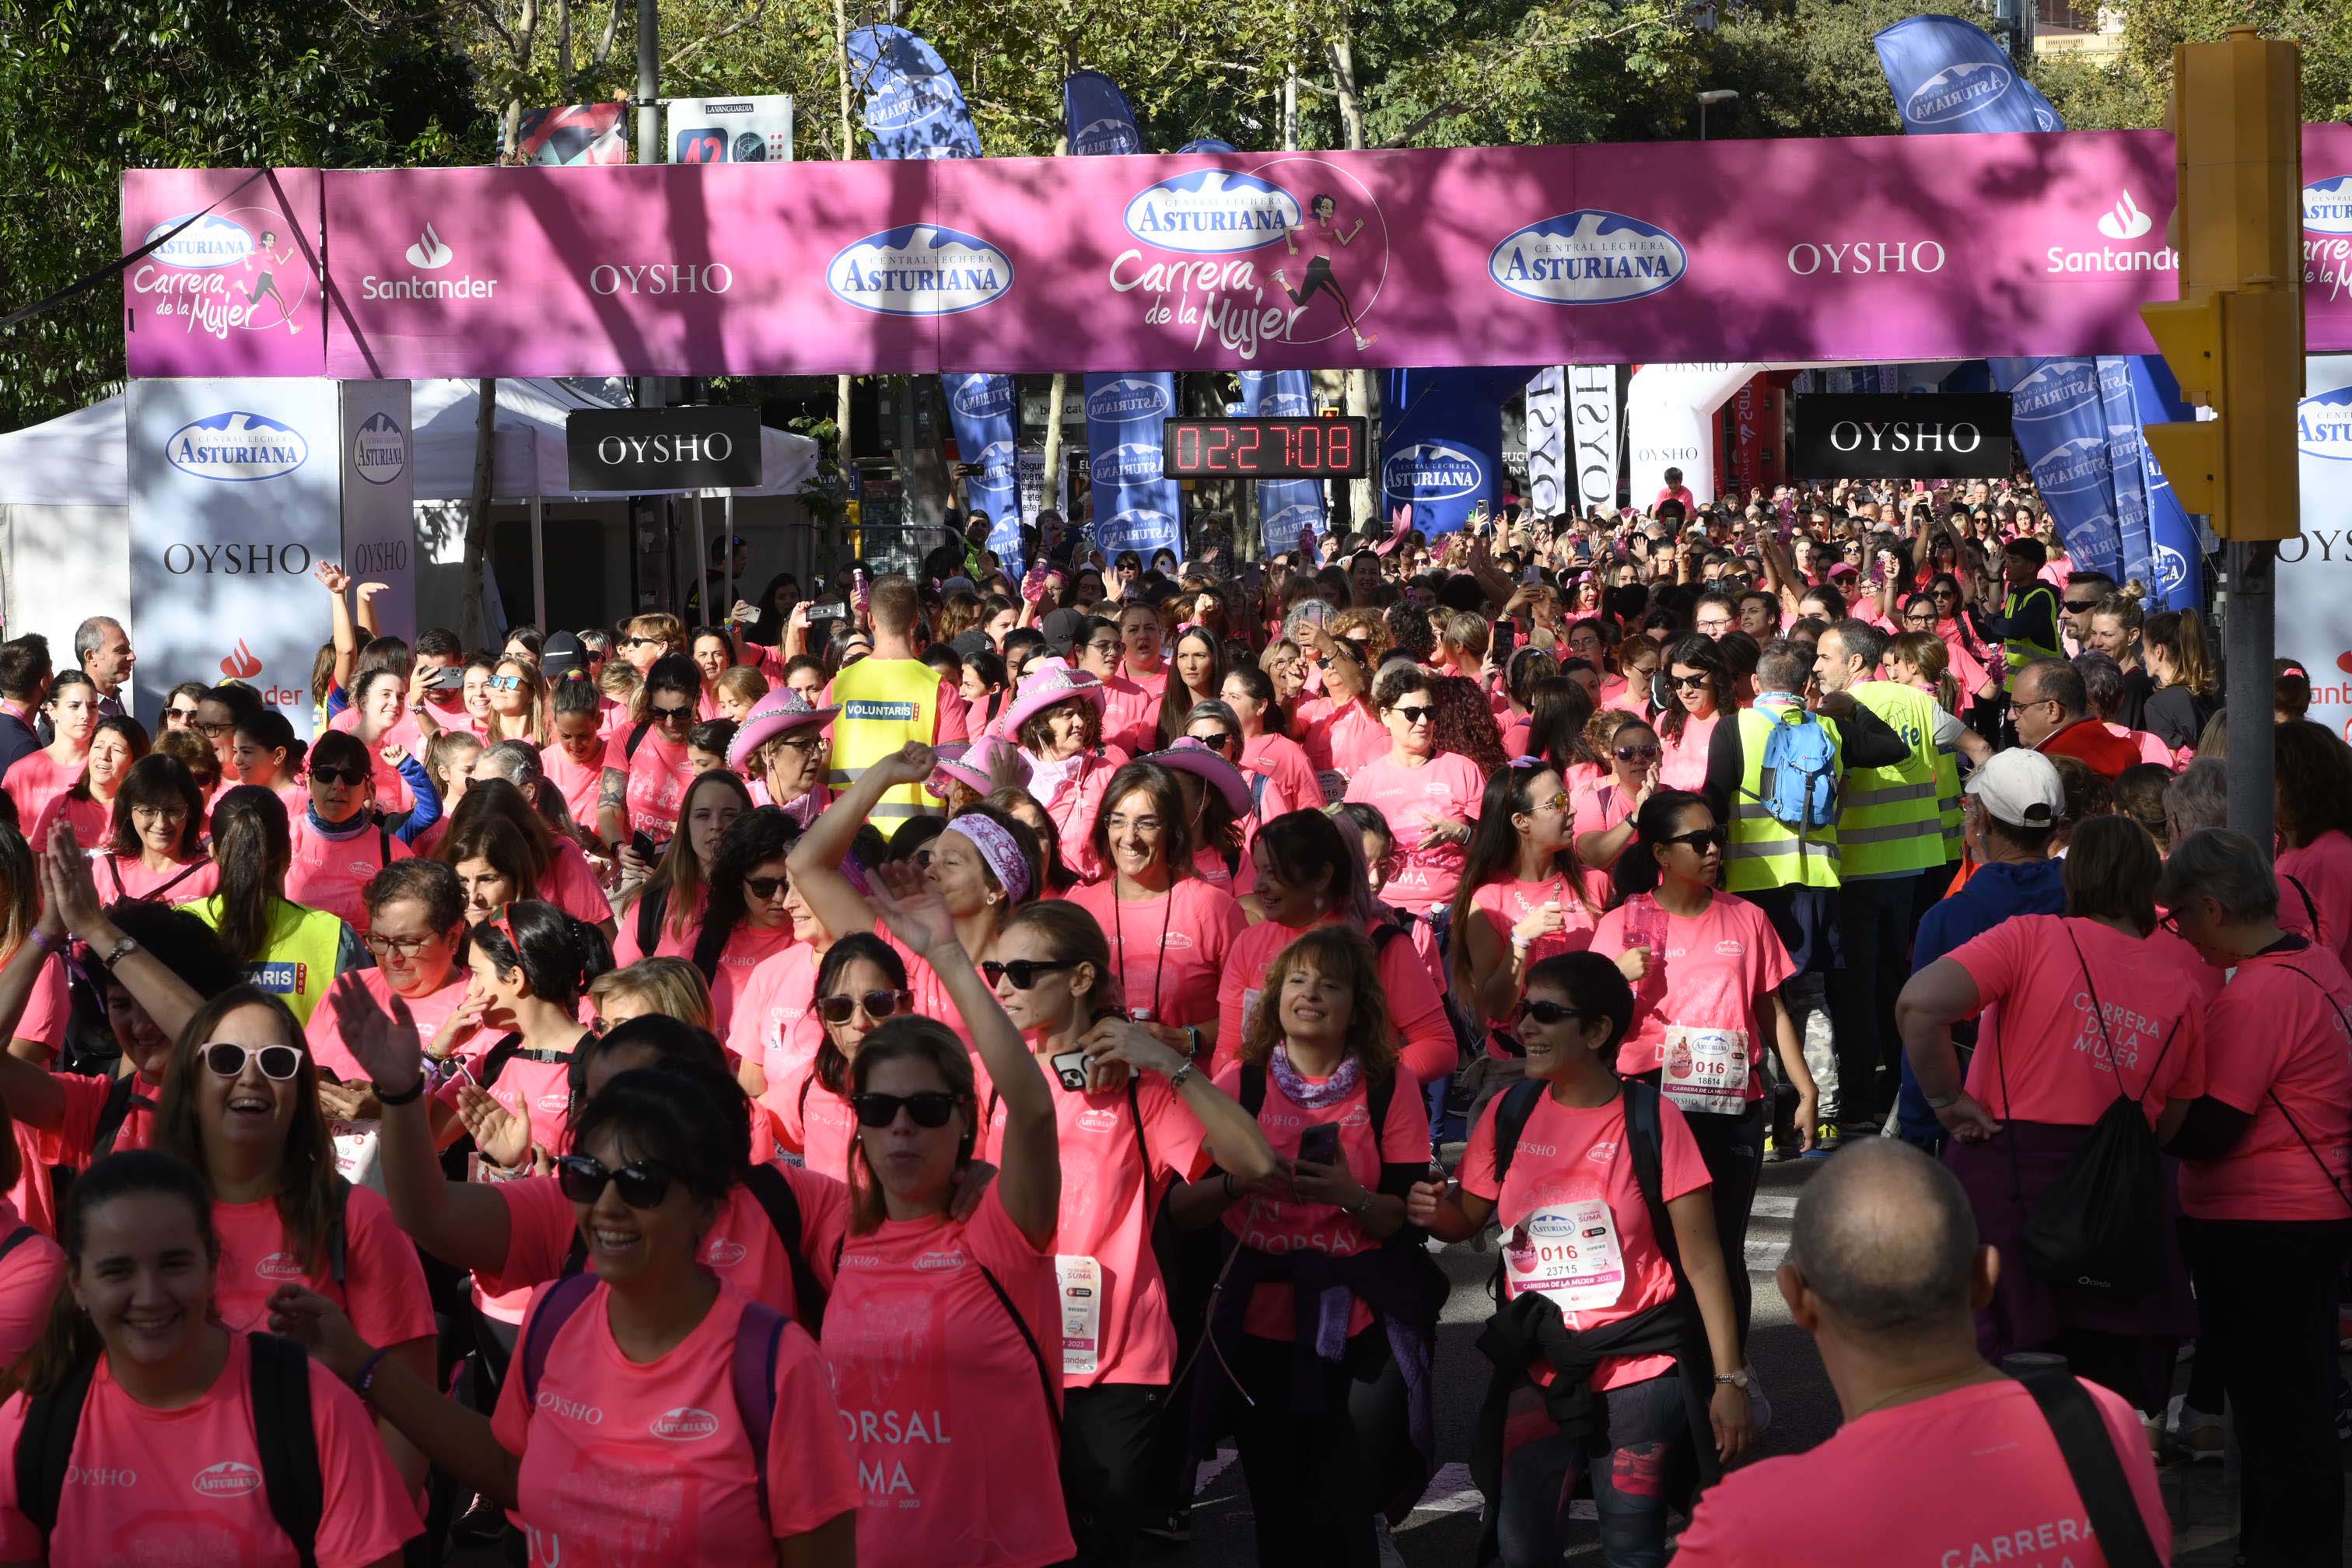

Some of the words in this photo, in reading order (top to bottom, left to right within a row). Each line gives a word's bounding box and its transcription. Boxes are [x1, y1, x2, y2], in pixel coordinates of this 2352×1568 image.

[1138, 201, 1286, 232] ASTURIANA
[1535, 243, 1594, 253] CENTRAL
[1602, 241, 1665, 250] LECHERA
[1787, 240, 1945, 275] OYSHO
[2047, 246, 2181, 274] Santande
[842, 258, 999, 292] ASTURIANA
[1109, 249, 1255, 292] Carrera
[1504, 246, 1672, 281] ASTURIANA
[134, 264, 226, 294] Carrera
[362, 275, 498, 300] Santander
[590, 263, 733, 296] OYSHO
[156, 296, 173, 316] de
[177, 294, 189, 315] la
[187, 292, 260, 339] Mujer
[1145, 295, 1172, 325] de
[1178, 294, 1198, 324] la
[1194, 286, 1310, 360] Mujer
[177, 437, 298, 464] ASTURIANA
[597, 432, 733, 465] OYSHO
[1177, 426, 1351, 470] 02:27:08
[1830, 421, 1981, 453] OYSHO
[357, 439, 403, 467] ASTURIANA
[1639, 446, 1699, 463] OYSHO
[1387, 467, 1475, 488] ASTURIANA
[163, 543, 311, 575] OYSHO
[355, 540, 407, 575] OYSHO
[847, 705, 911, 716] VOLUNTARIS
[1399, 870, 1428, 885] MA
[2073, 992, 2160, 1039] CARRERA
[1696, 1041, 1727, 1051] ASTURIANA
[2119, 1026, 2138, 1052] LA
[1696, 1061, 1725, 1074] 016
[1699, 1076, 1720, 1086] 18614
[1532, 1224, 1574, 1234] ASTURIANA
[1578, 1213, 1602, 1223] SUMA
[1541, 1245, 1578, 1262] 016
[1546, 1265, 1577, 1276] 23715
[1571, 1277, 1594, 1286] MUJER
[537, 1391, 603, 1425] OYSHO
[859, 1459, 914, 1494] MA
